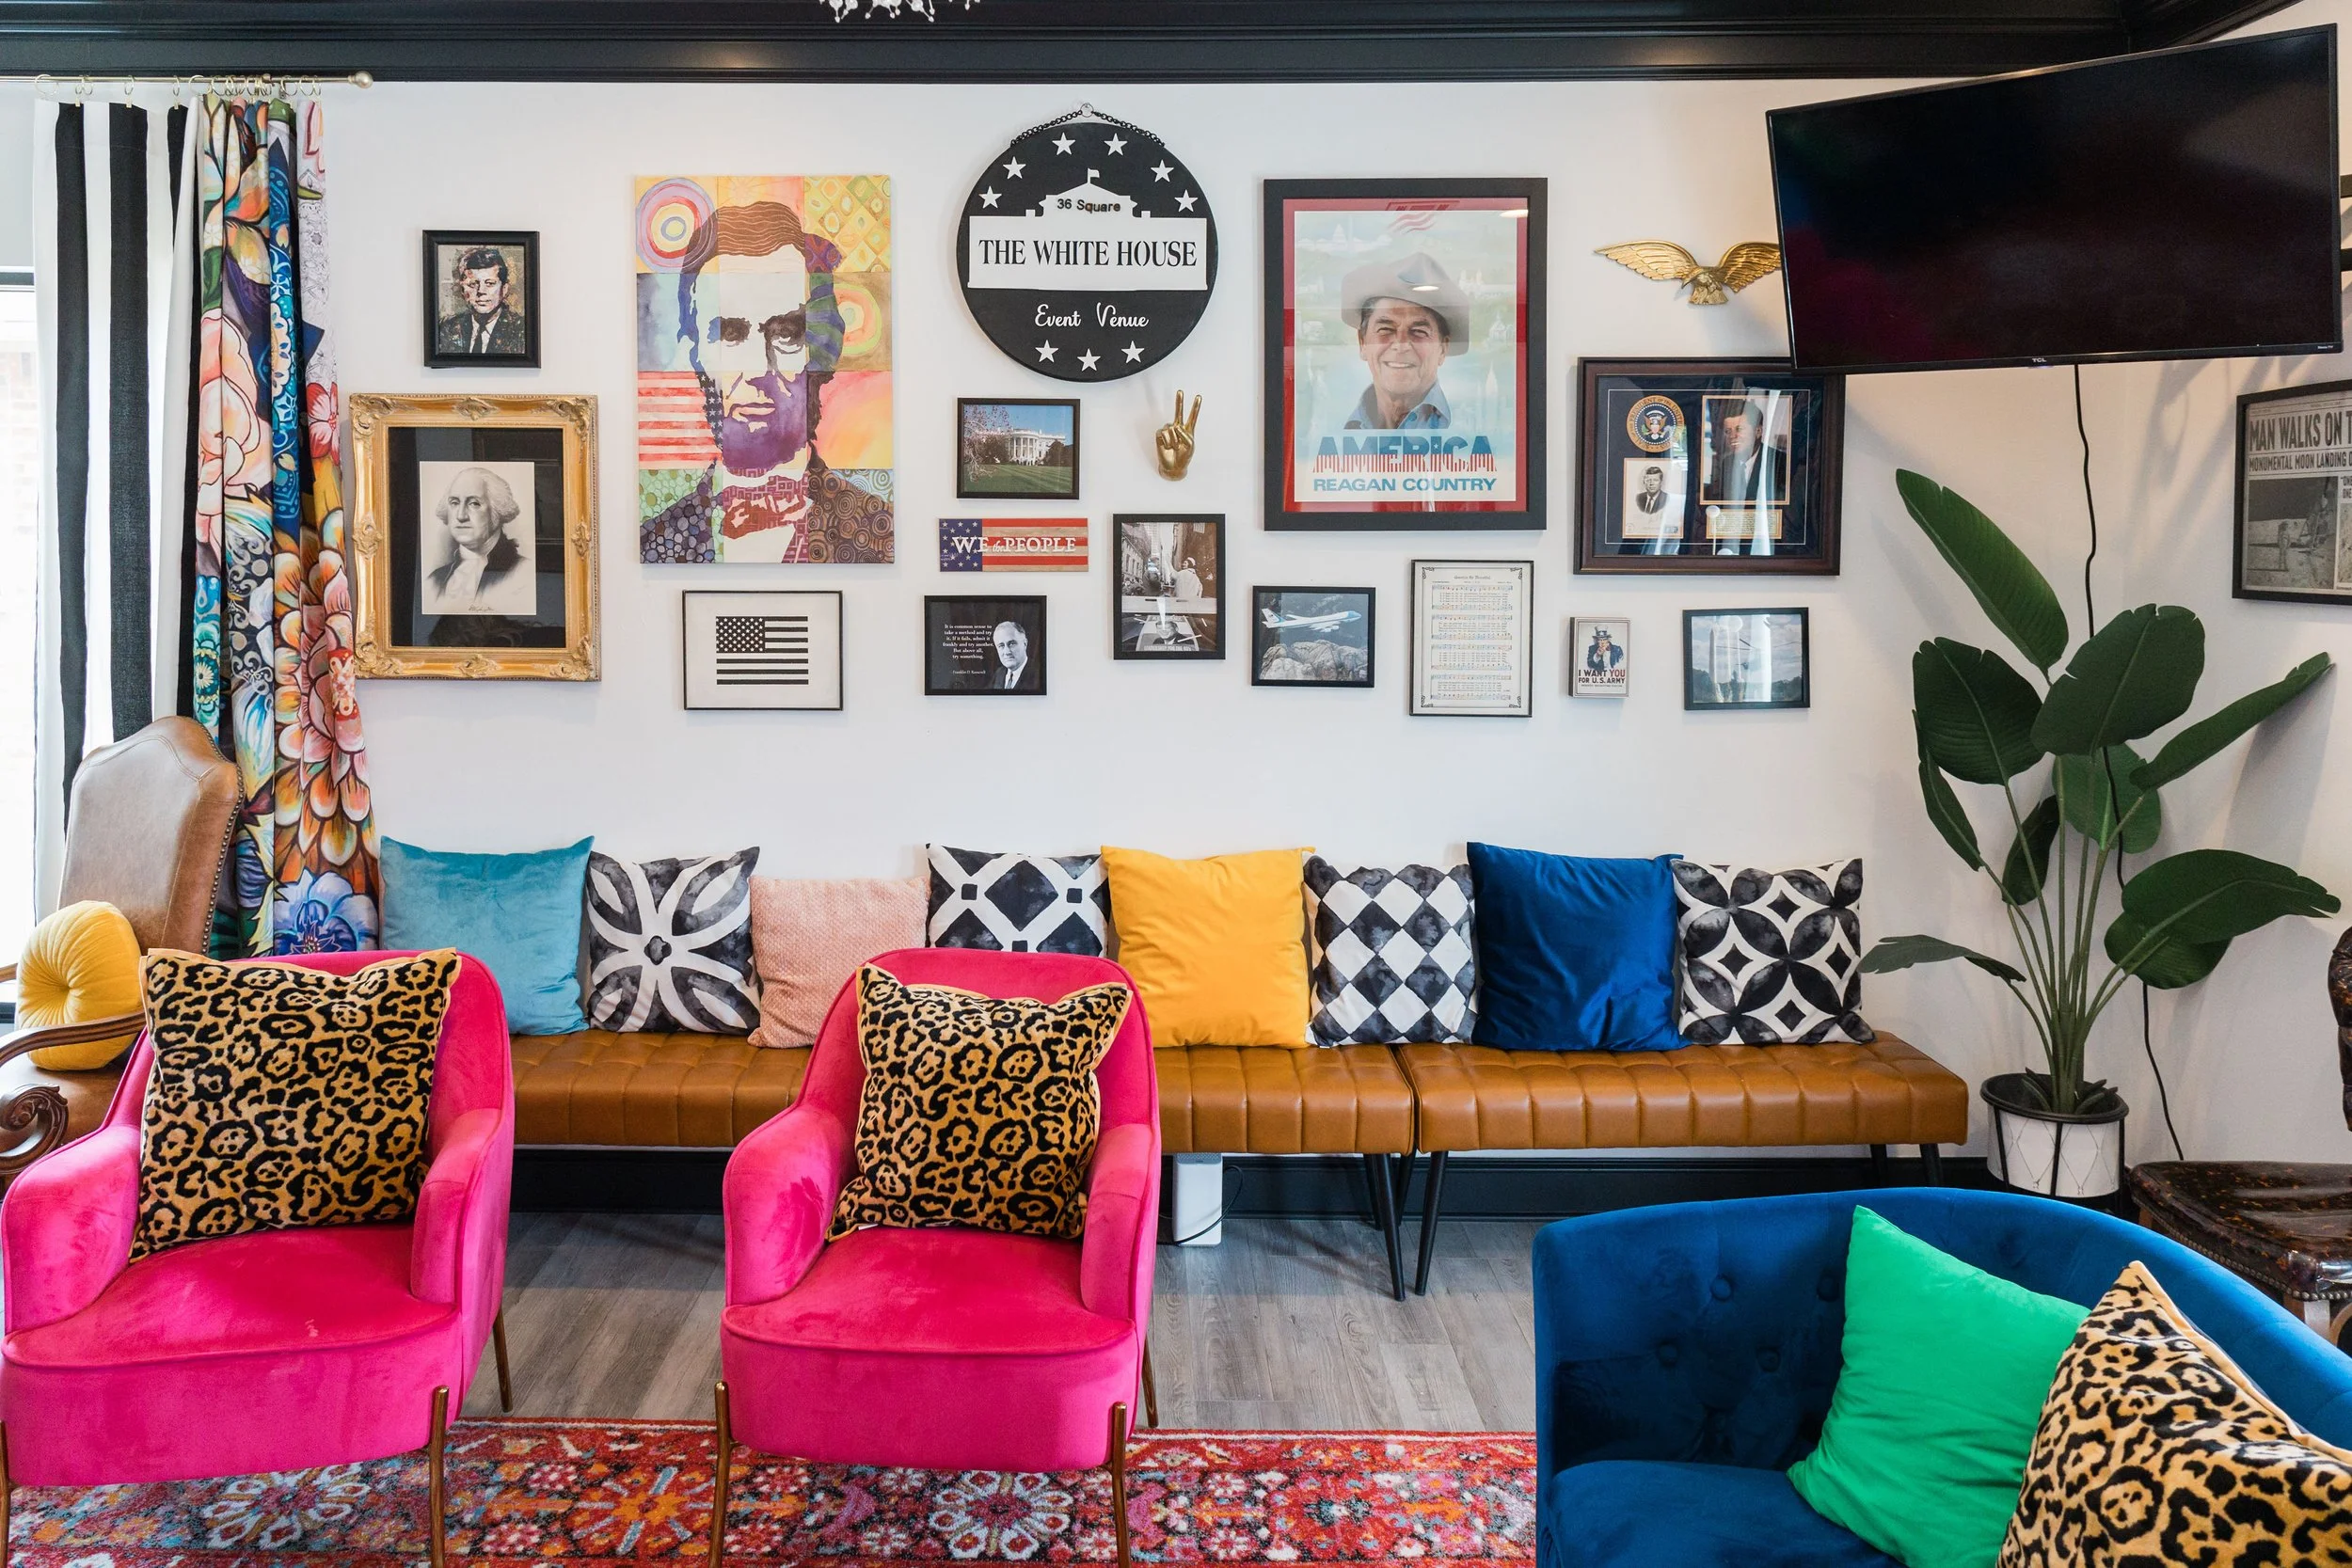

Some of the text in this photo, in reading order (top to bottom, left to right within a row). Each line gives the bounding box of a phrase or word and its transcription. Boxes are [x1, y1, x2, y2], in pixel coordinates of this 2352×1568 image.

[1057, 198, 1121, 214] 36 Square
[978, 239, 1198, 267] THE WHITE HOUSE
[1035, 302, 1150, 328] Event Venue
[2249, 419, 2275, 451] MAN
[2279, 414, 2321, 449] WALKS
[2325, 411, 2343, 447] ON
[1312, 436, 1498, 473] AMERICA
[2249, 455, 2293, 471] MONUMENTAL
[2296, 453, 2314, 469] MOON
[2317, 451, 2346, 468] LANDING
[1312, 478, 1498, 492] REAGAN COUNTRY
[952, 536, 1076, 553] WE the PEOPLE
